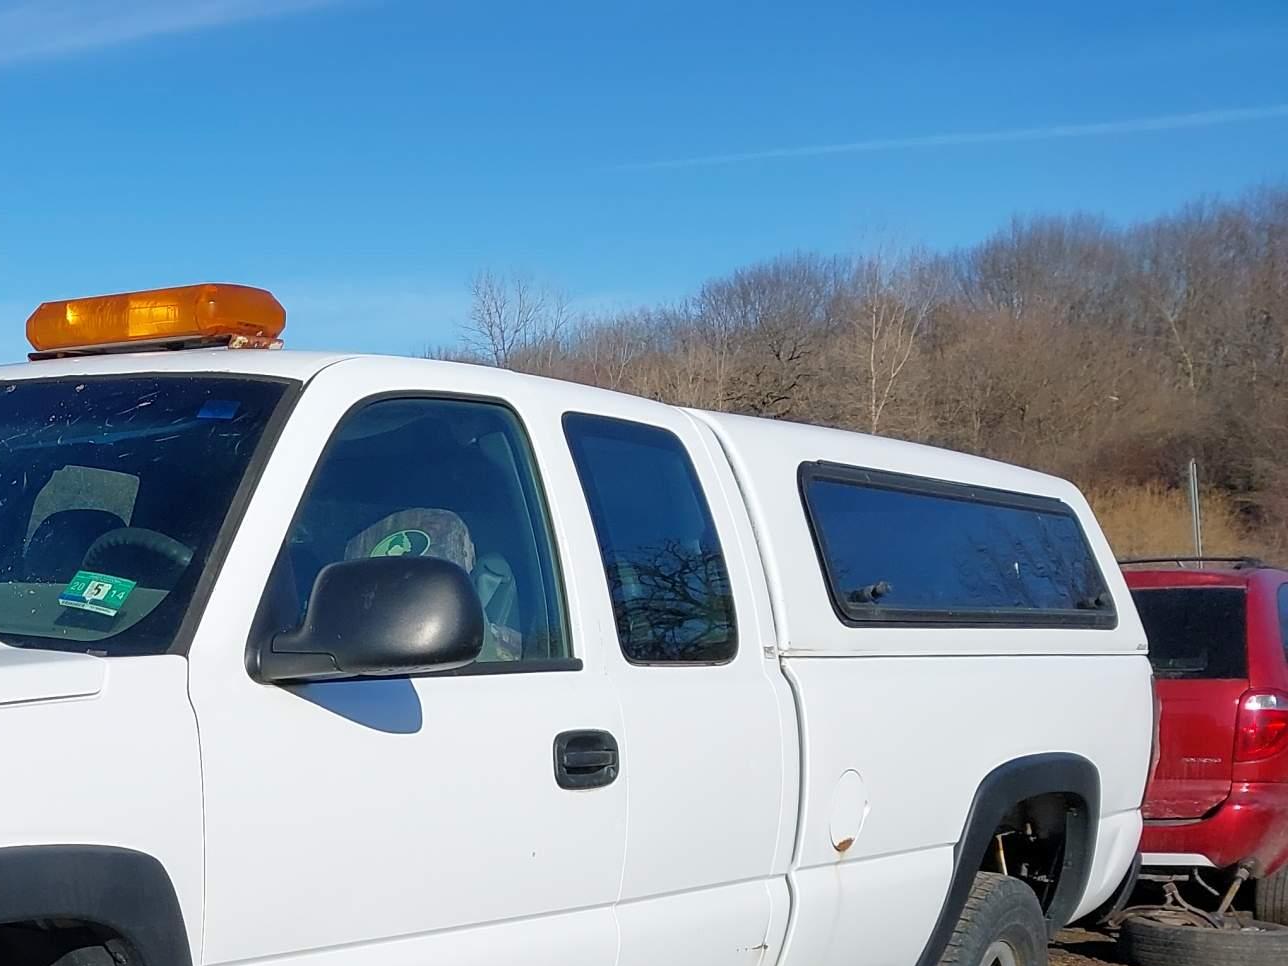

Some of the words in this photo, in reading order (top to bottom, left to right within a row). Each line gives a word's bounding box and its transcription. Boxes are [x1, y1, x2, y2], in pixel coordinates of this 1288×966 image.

[70, 581, 86, 591] 20
[93, 584, 105, 596] 5
[110, 590, 126, 600] 14
